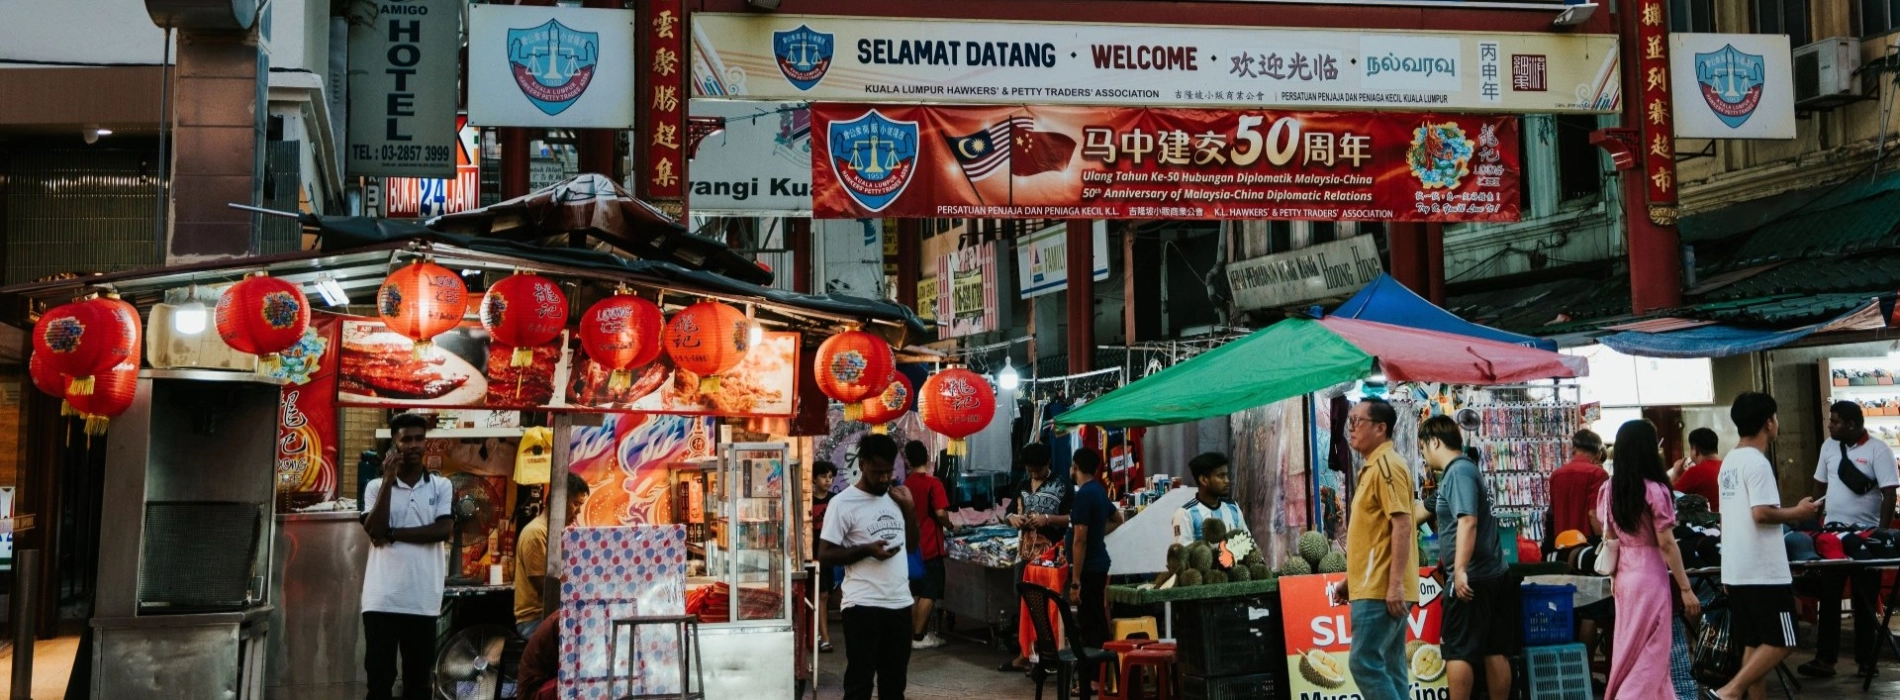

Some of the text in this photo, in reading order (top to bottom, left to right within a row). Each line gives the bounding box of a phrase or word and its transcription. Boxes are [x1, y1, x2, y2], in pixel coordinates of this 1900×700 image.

[380, 5, 428, 15] AMIGO
[857, 38, 1198, 71] SELAMAT DATANG WELCOME
[1229, 50, 1339, 82] 欢迎光临
[1366, 52, 1456, 77] நல்வரவு
[1480, 43, 1500, 101] 丙申年
[385, 19, 421, 142] HOTEL
[531, 81, 576, 95] KUALA LUMPUR
[865, 84, 1160, 98] KUALA LUMPUR HAWKERS' & PETTY TRADERS' ASSOCIATION
[1281, 91, 1448, 103] PERSATUAN PENJAJA DAN PENIAGA KECIL KUALA LUMPUR
[353, 144, 372, 160] TEL
[382, 145, 421, 161] 03-2857
[425, 146, 449, 162] 3999
[854, 175, 898, 188] KUALA LUMPUR
[1083, 171, 1372, 187] Ulang Tahun Ke-50 Hubungan Diplomatik Malaysia-China
[390, 172, 476, 216] BUKA 24 JAM
[770, 178, 812, 197] Ku
[1083, 188, 1372, 202] 50th Anniversary of Malaysia-China Diplomatic Relations
[937, 205, 1119, 215] PERSATUAN PENJAJA DAN PENIAGA KECIL K.L.
[1214, 208, 1393, 218] K.L. HAWKERS' & PETTY TRADERS' ASSOCIATION
[1416, 202, 1430, 215] Try
[1044, 243, 1066, 275] FAMILY
[1419, 585, 1436, 596] 0m
